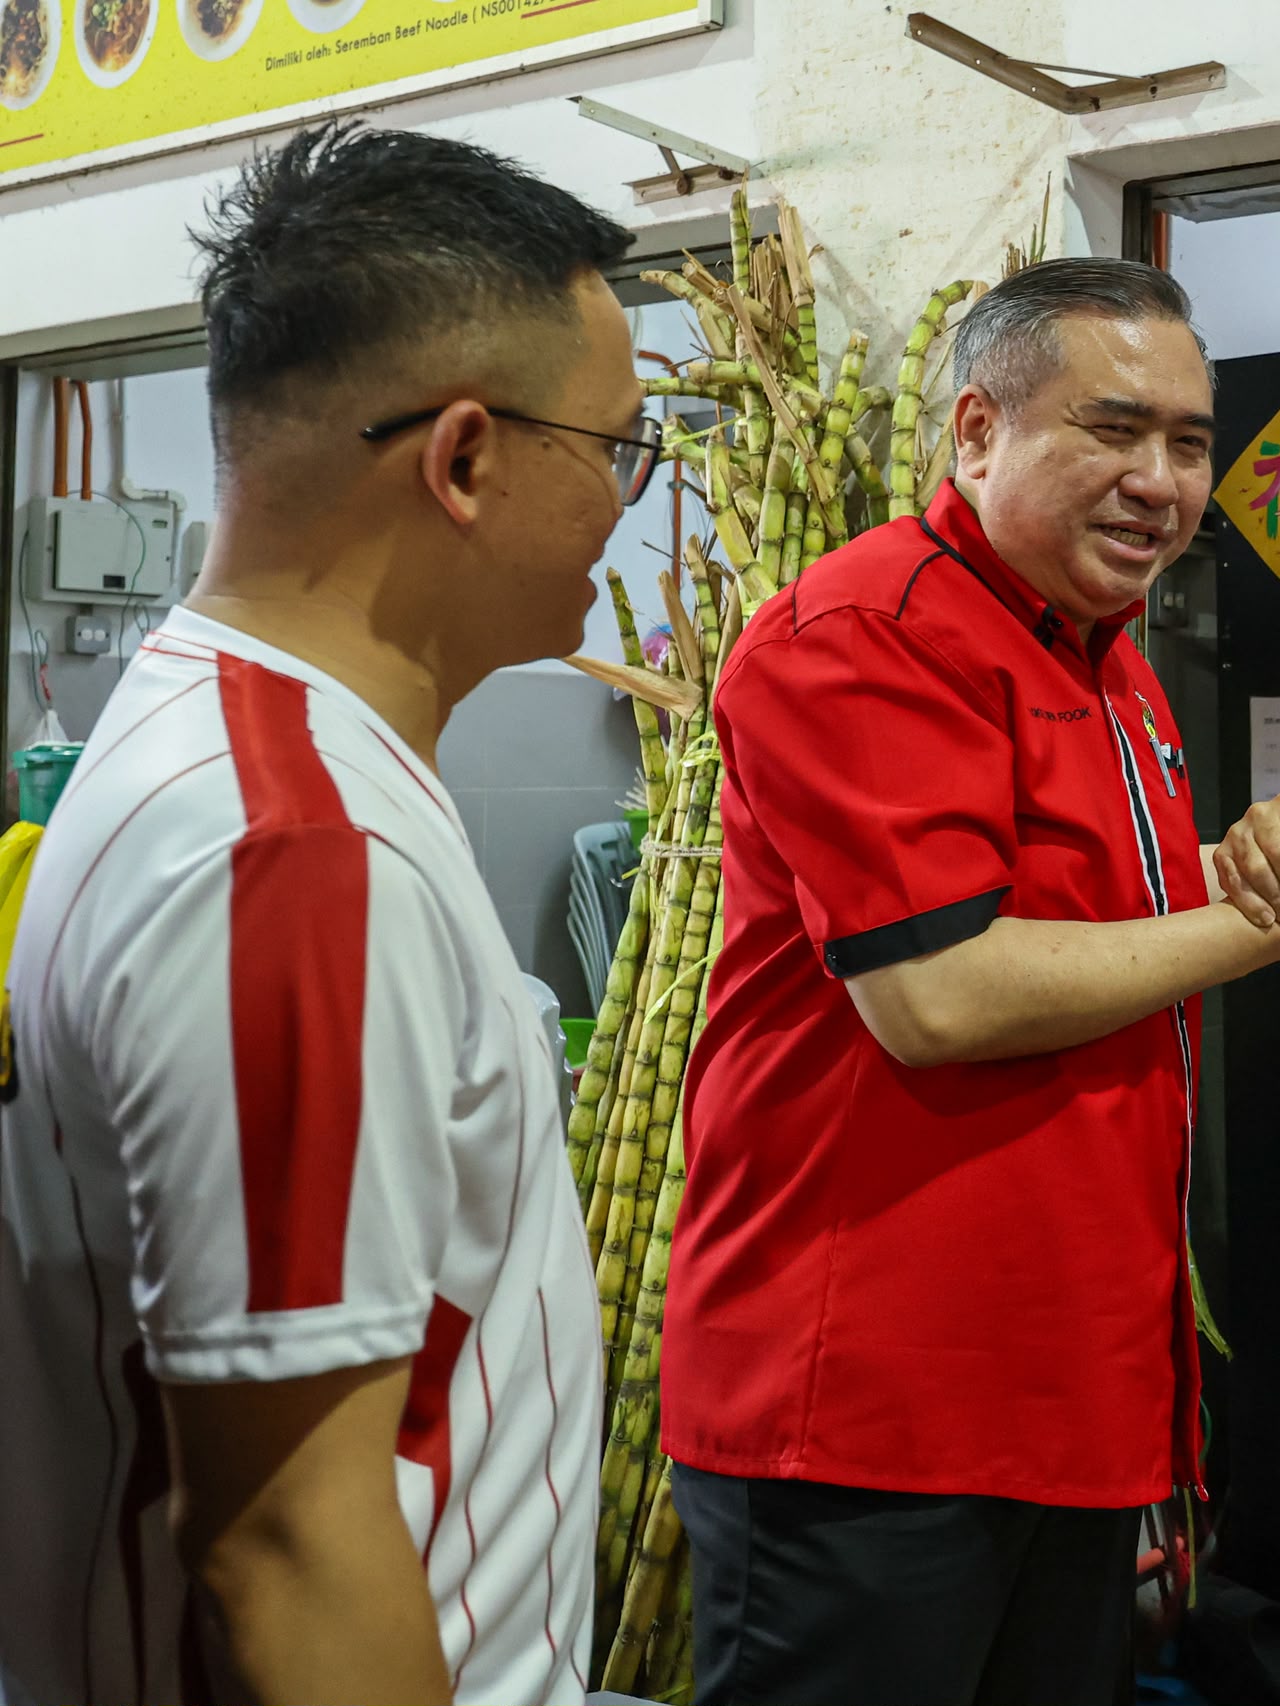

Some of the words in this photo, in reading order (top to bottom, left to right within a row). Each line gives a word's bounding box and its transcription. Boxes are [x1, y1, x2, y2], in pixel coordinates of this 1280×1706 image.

[265, 50, 303, 72] Dimiliki
[335, 31, 391, 55] Seremban
[395, 20, 421, 40] Beef
[425, 11, 468, 33] Noodle
[1057, 706, 1092, 723] FOOK
